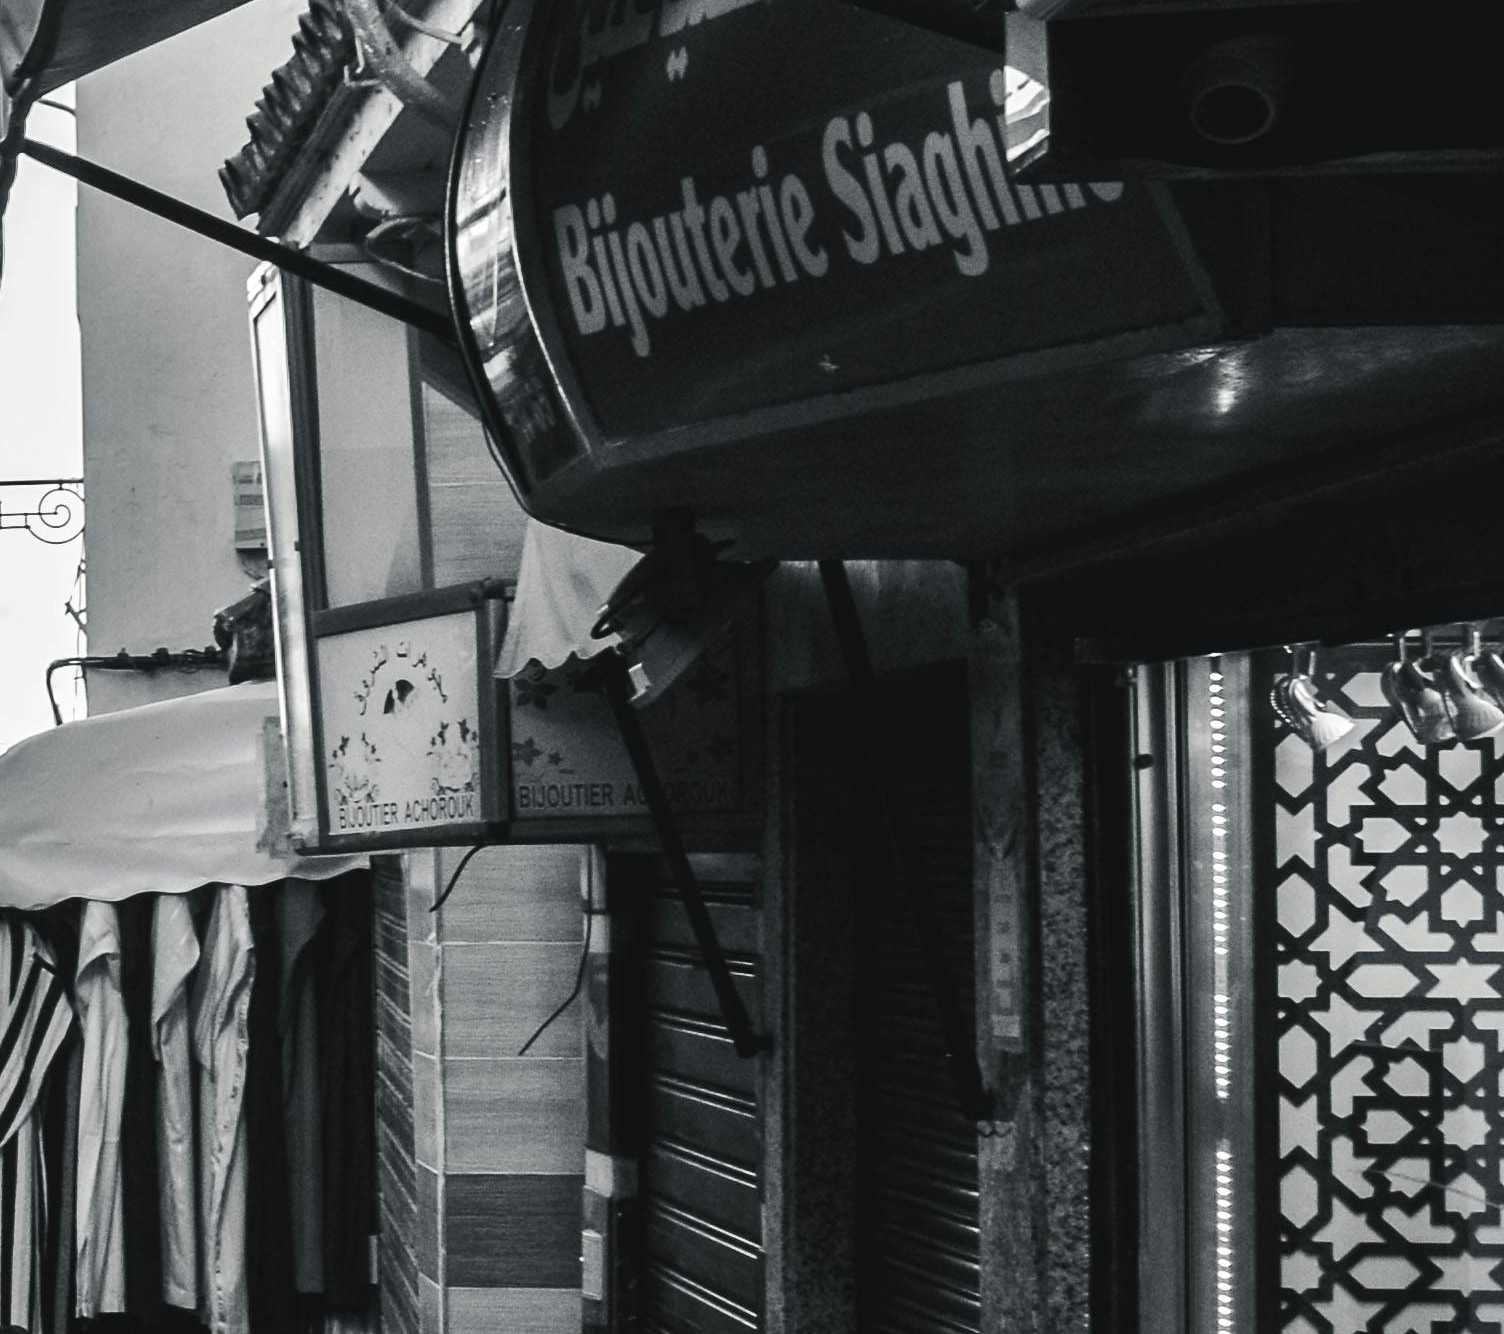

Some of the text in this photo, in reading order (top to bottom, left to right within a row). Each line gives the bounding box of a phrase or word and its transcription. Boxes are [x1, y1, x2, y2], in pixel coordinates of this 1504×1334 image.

[552, 145, 829, 357] Bijouterie
[339, 794, 475, 830] BIJOUTIER ACHOROUK
[519, 783, 615, 808] BIJOUTIER
